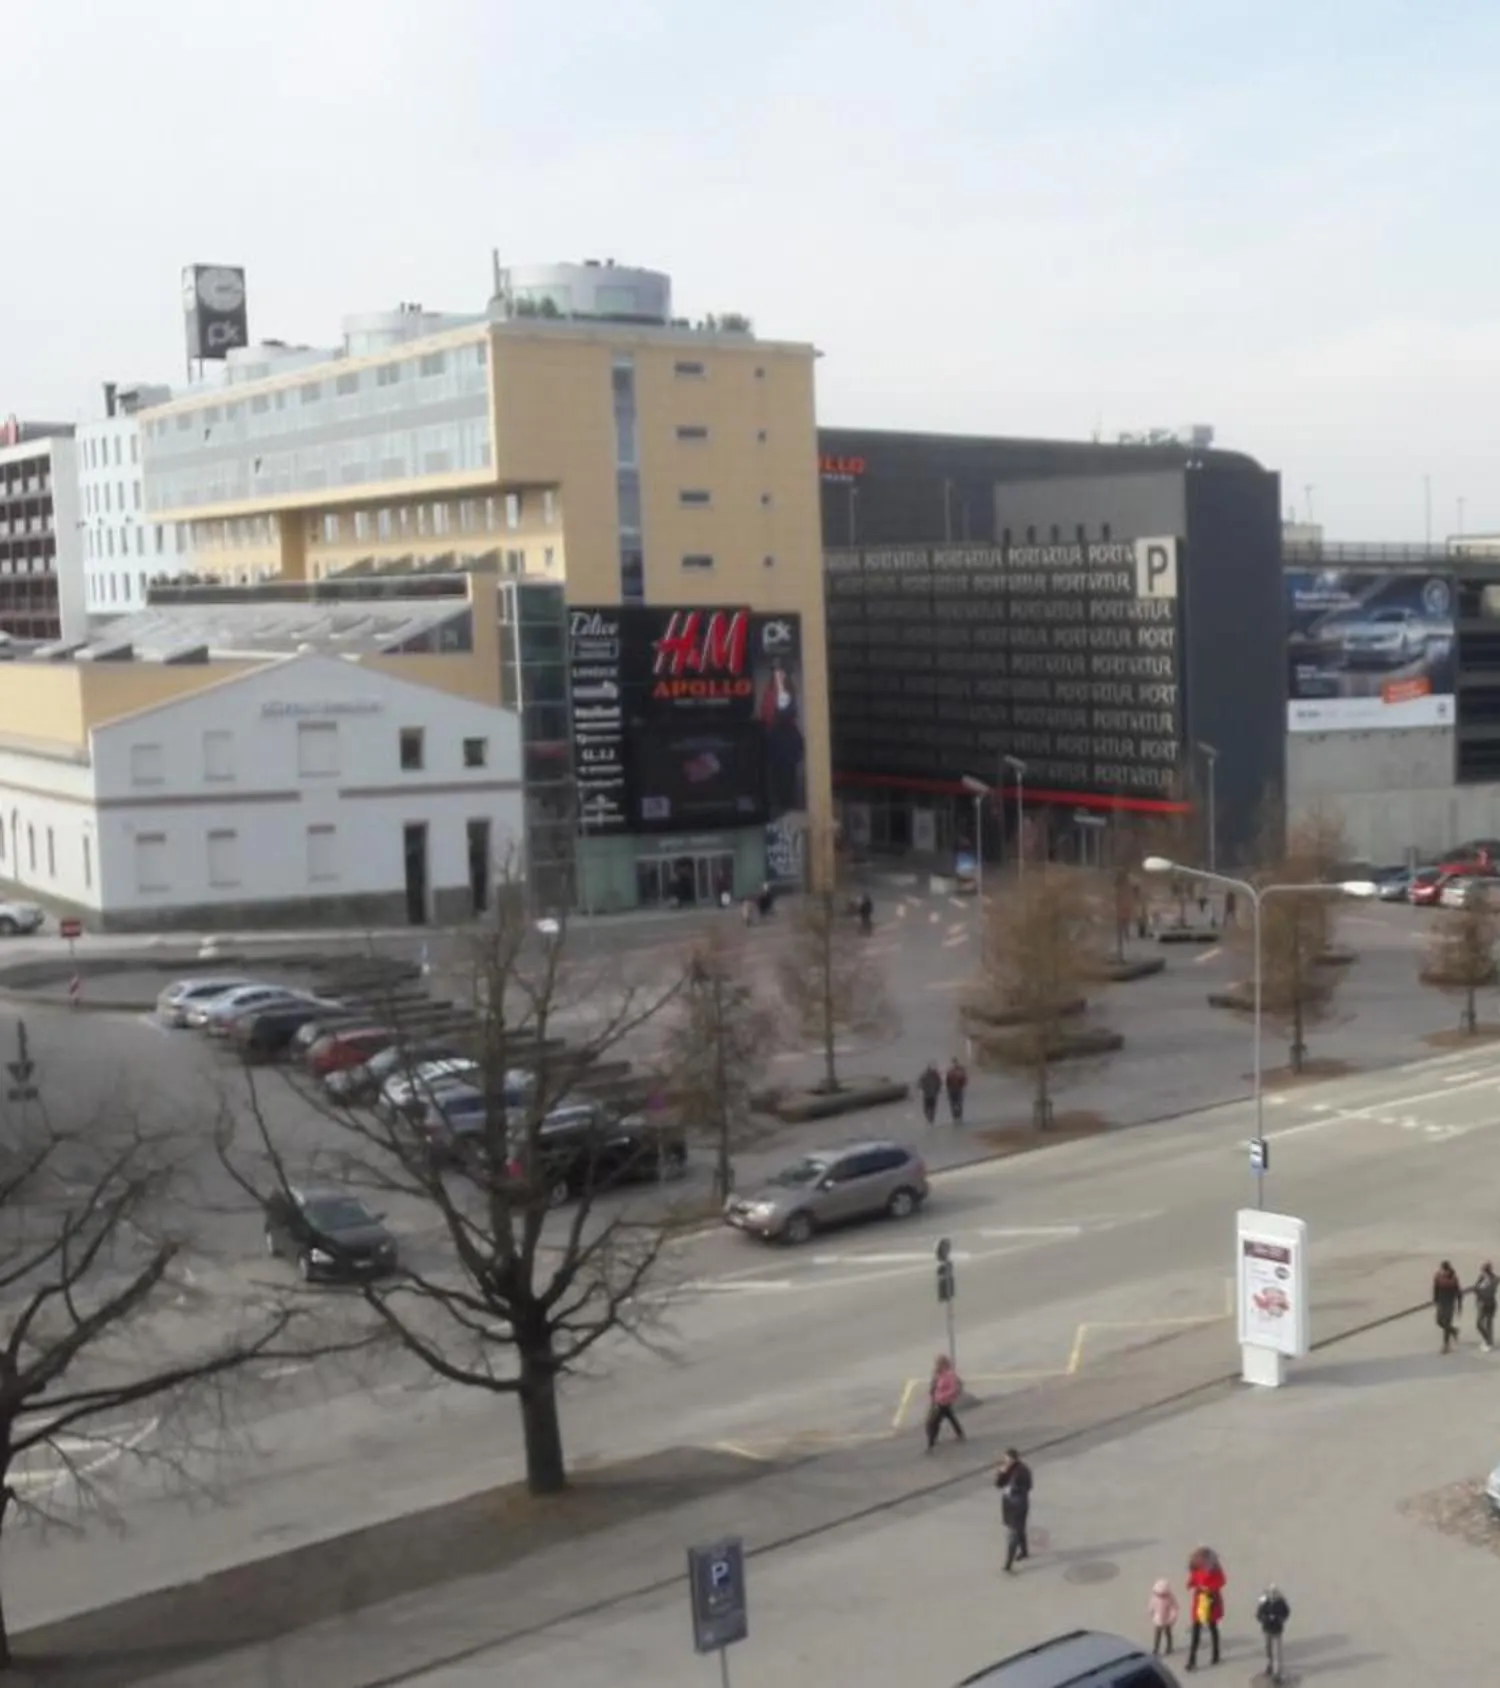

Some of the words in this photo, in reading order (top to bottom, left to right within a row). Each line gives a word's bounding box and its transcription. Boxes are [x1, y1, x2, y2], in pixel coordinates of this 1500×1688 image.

[1146, 543, 1169, 594] P
[1137, 626, 1175, 650] PORT
[653, 680, 751, 698] APOLLO
[1138, 683, 1178, 706] PORT
[711, 1560, 729, 1587] P
